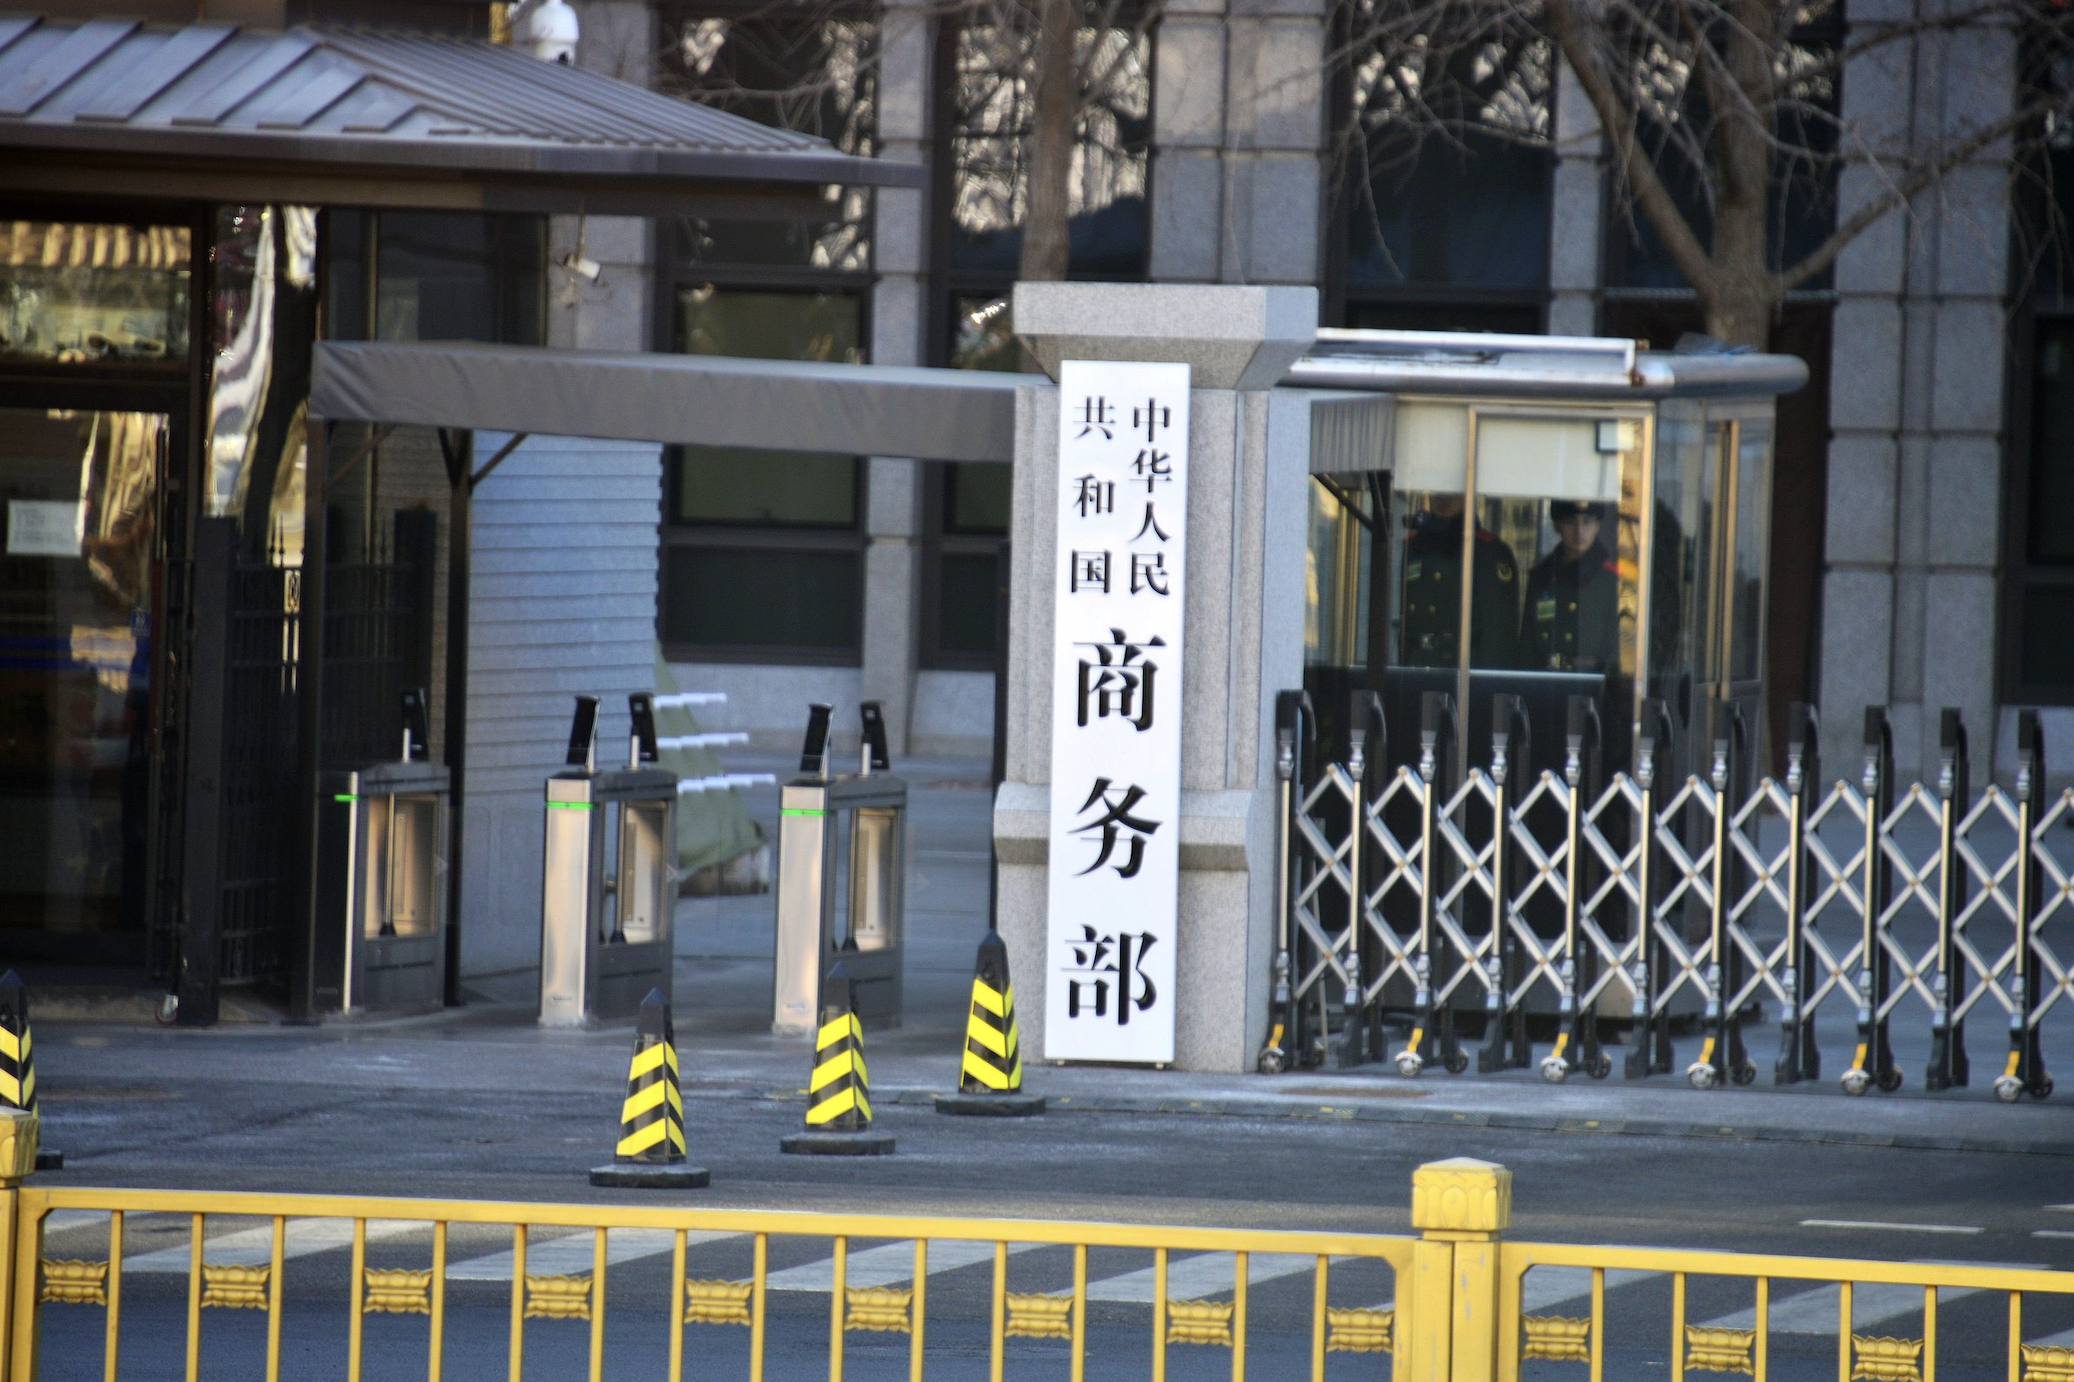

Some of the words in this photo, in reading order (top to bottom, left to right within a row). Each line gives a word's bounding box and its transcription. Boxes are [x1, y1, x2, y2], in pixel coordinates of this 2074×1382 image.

[1071, 396, 1116, 594] 共和国
[1129, 397, 1173, 597] 中华人民
[1061, 627, 1167, 1026] 商务部
